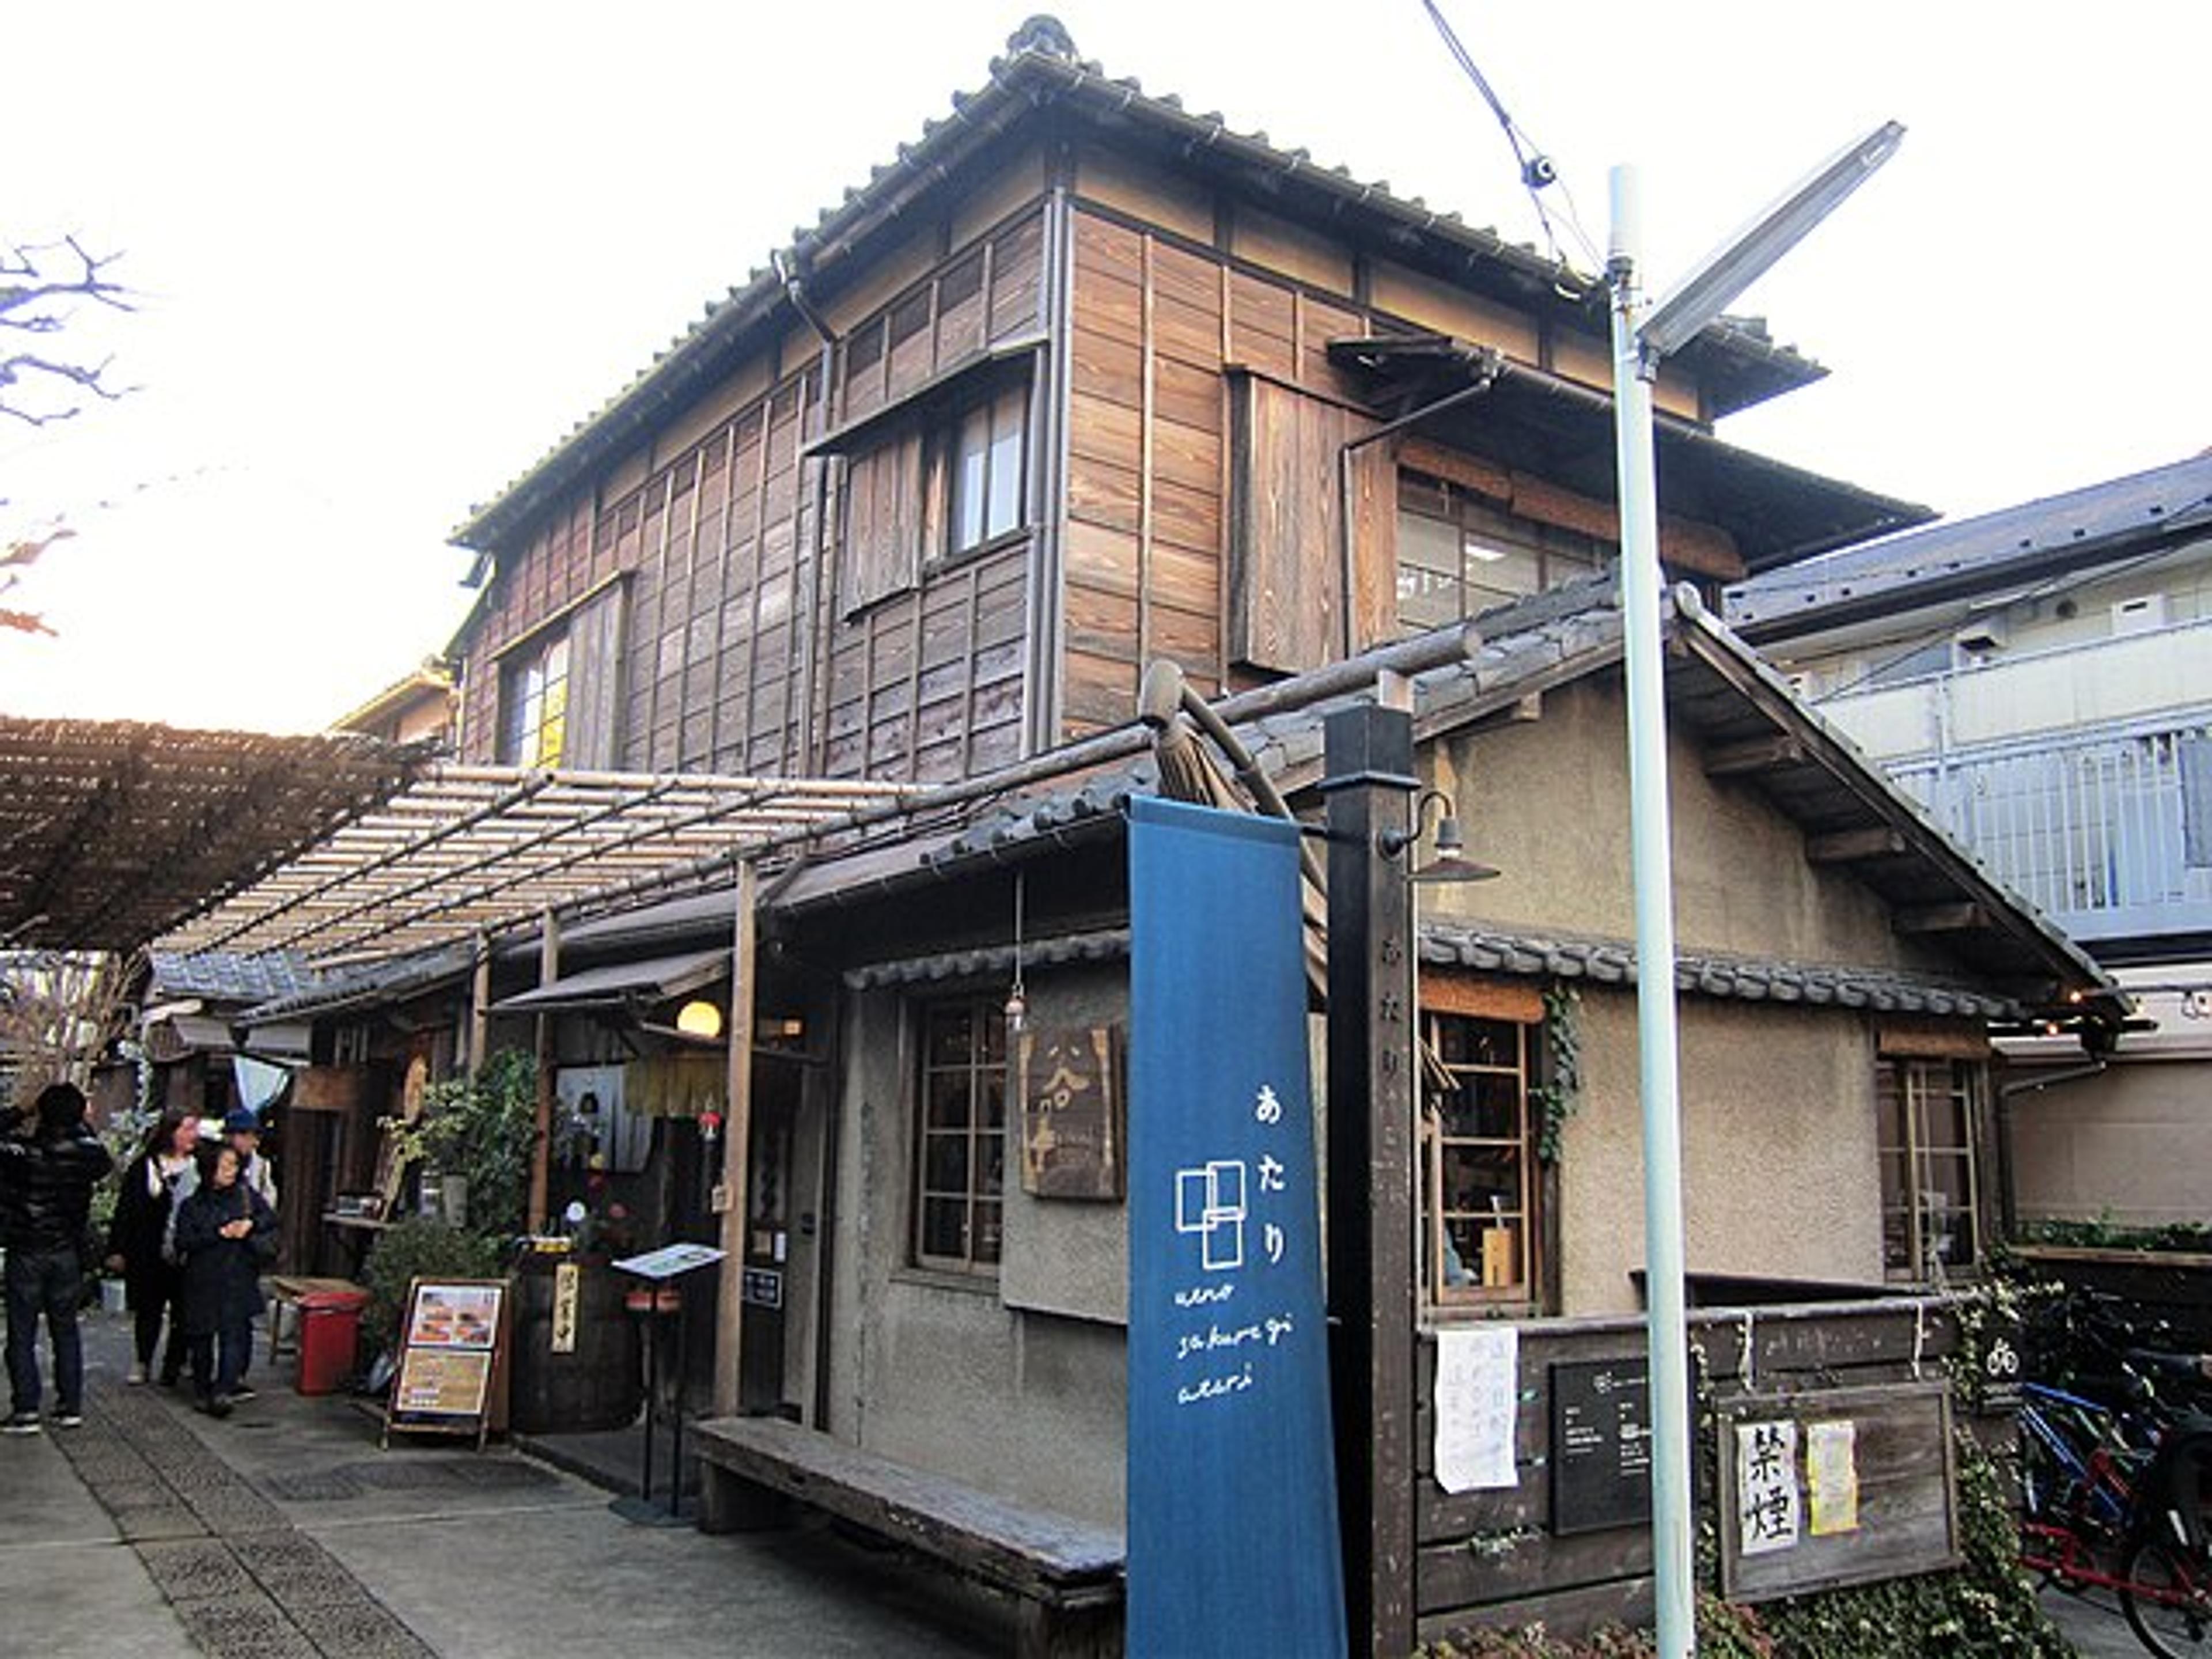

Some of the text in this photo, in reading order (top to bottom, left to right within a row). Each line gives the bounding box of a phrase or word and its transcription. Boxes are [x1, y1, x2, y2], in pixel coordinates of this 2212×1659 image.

[1256, 1085, 1286, 1263] あたり
[1175, 1283, 1234, 1308] ueno
[1745, 1427, 1793, 1540] 禁煙
